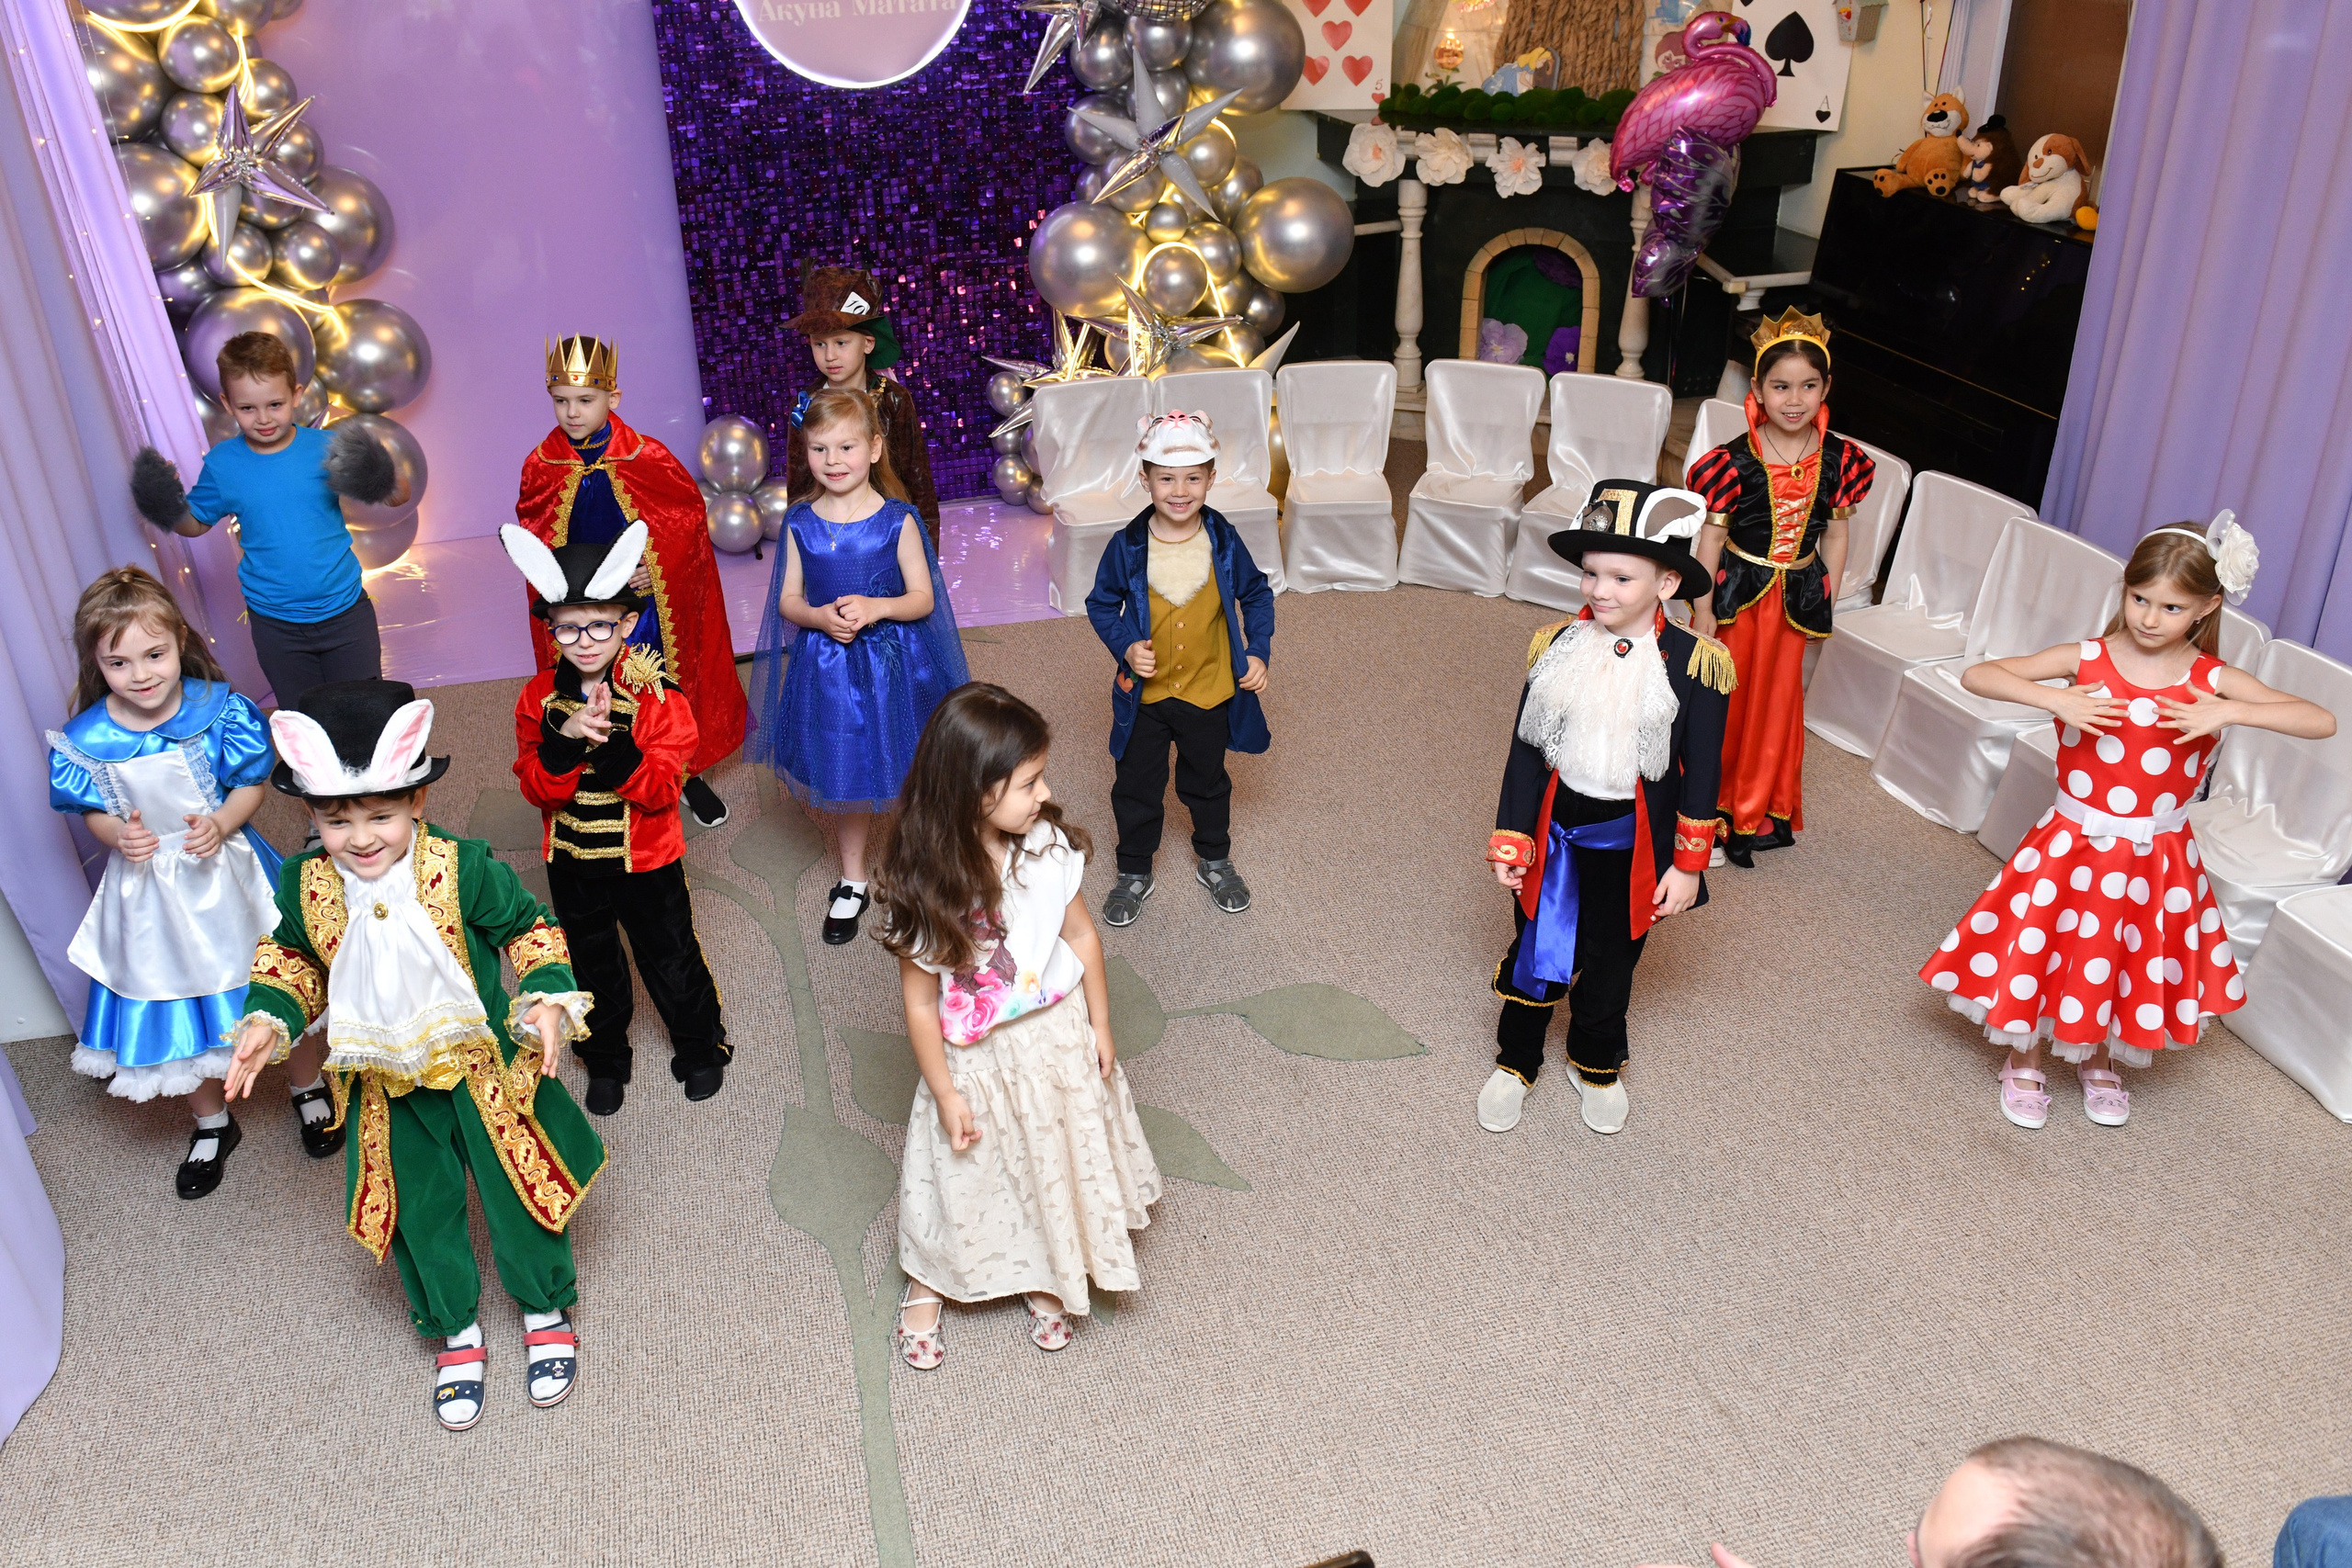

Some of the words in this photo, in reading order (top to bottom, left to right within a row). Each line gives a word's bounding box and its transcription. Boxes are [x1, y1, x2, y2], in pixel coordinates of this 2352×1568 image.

[759, 0, 841, 27] Акуна
[1374, 78, 1383, 90] 5
[1819, 95, 1829, 109] A
